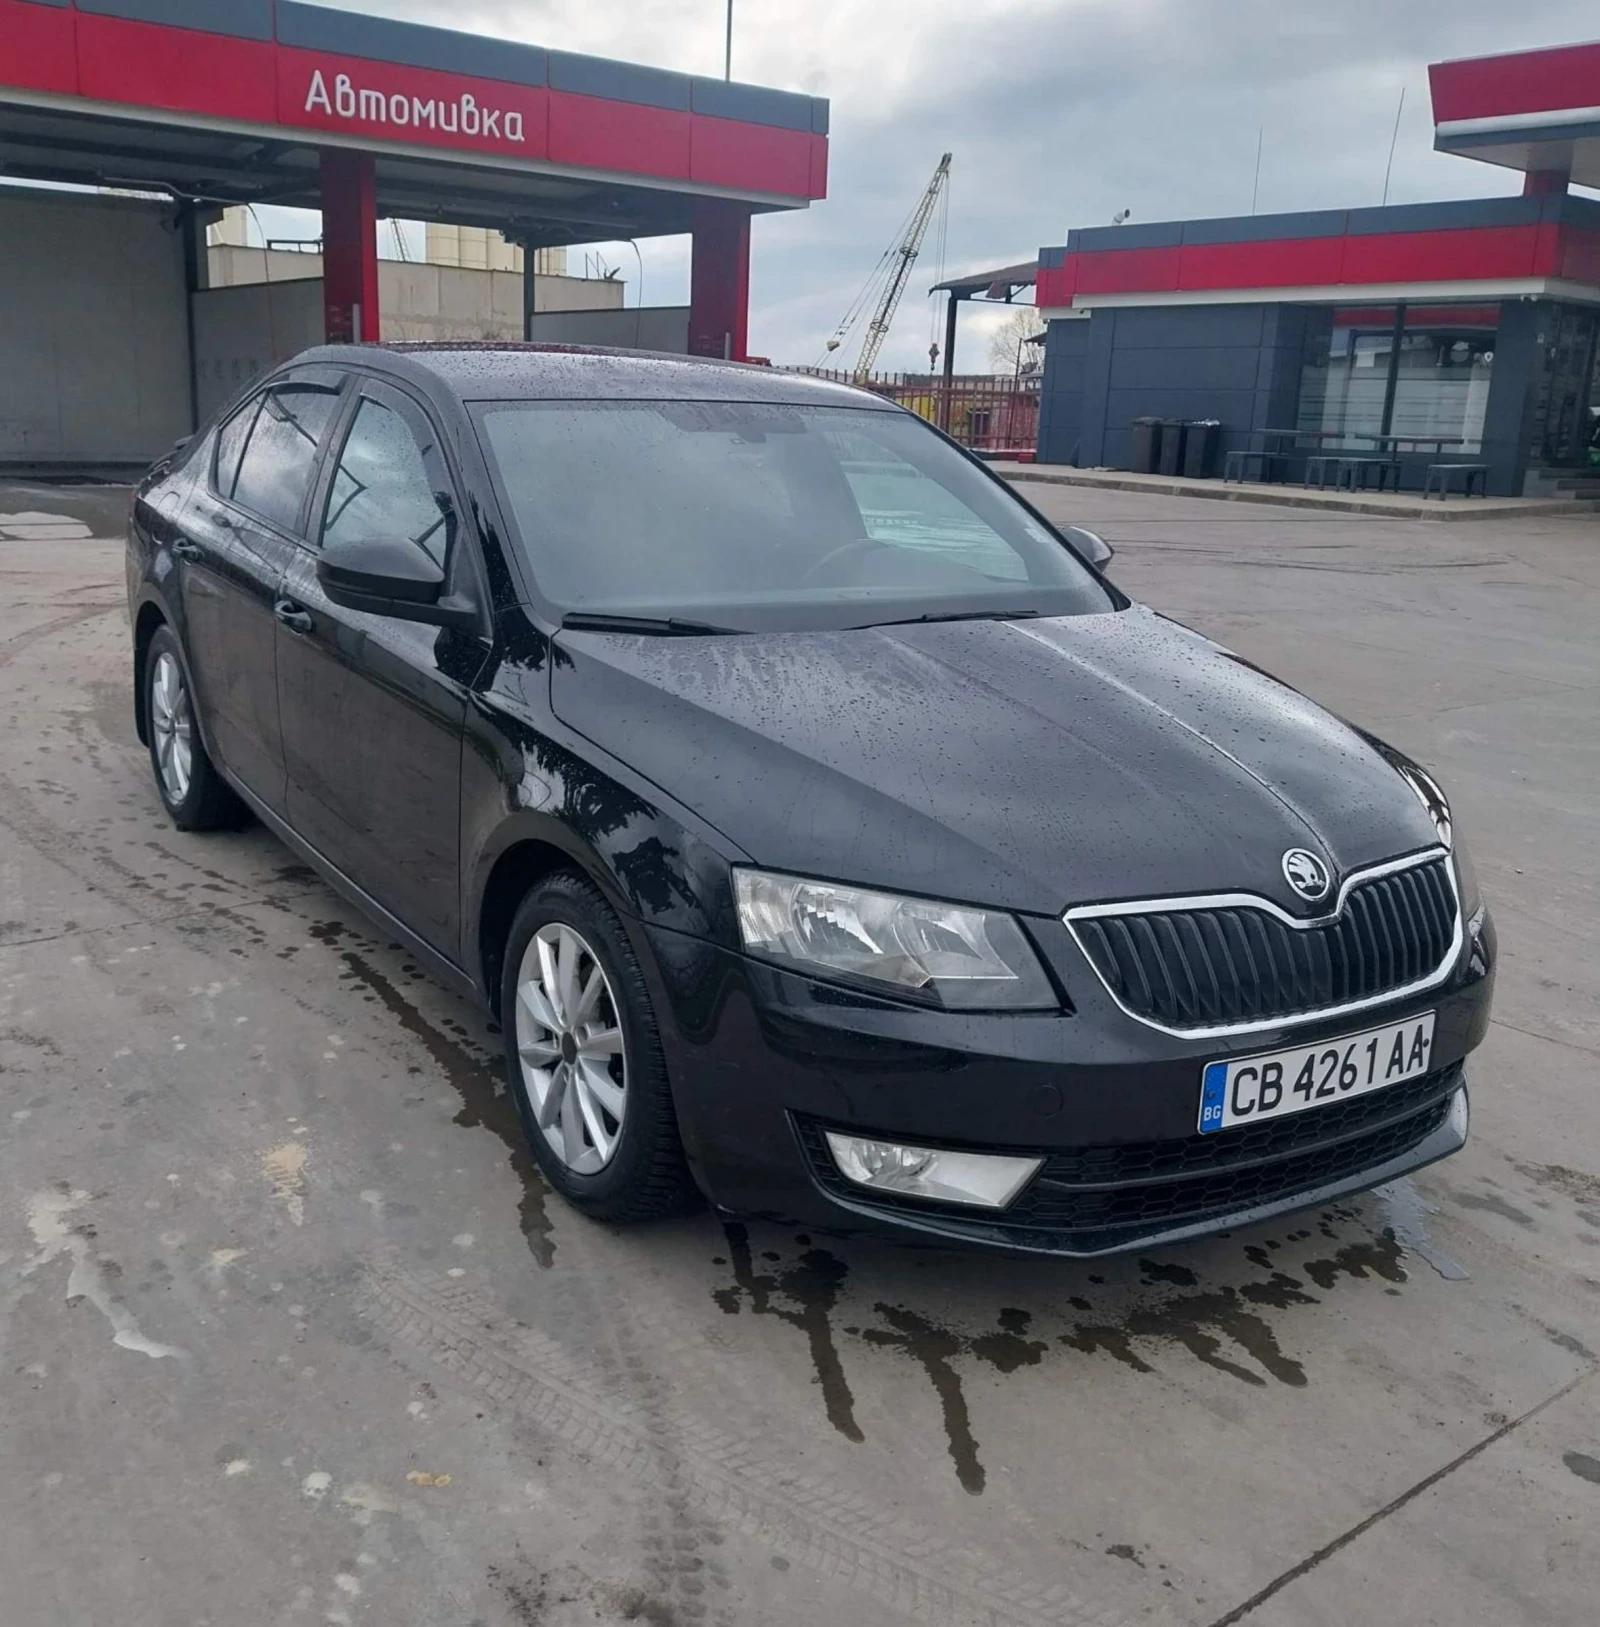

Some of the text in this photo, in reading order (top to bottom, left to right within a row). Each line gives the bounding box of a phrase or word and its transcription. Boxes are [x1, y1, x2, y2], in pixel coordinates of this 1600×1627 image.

[304, 69, 525, 142] Автомивка
[1231, 1024, 1424, 1117] CB 4261 AA
[1203, 1105, 1222, 1122] BG
